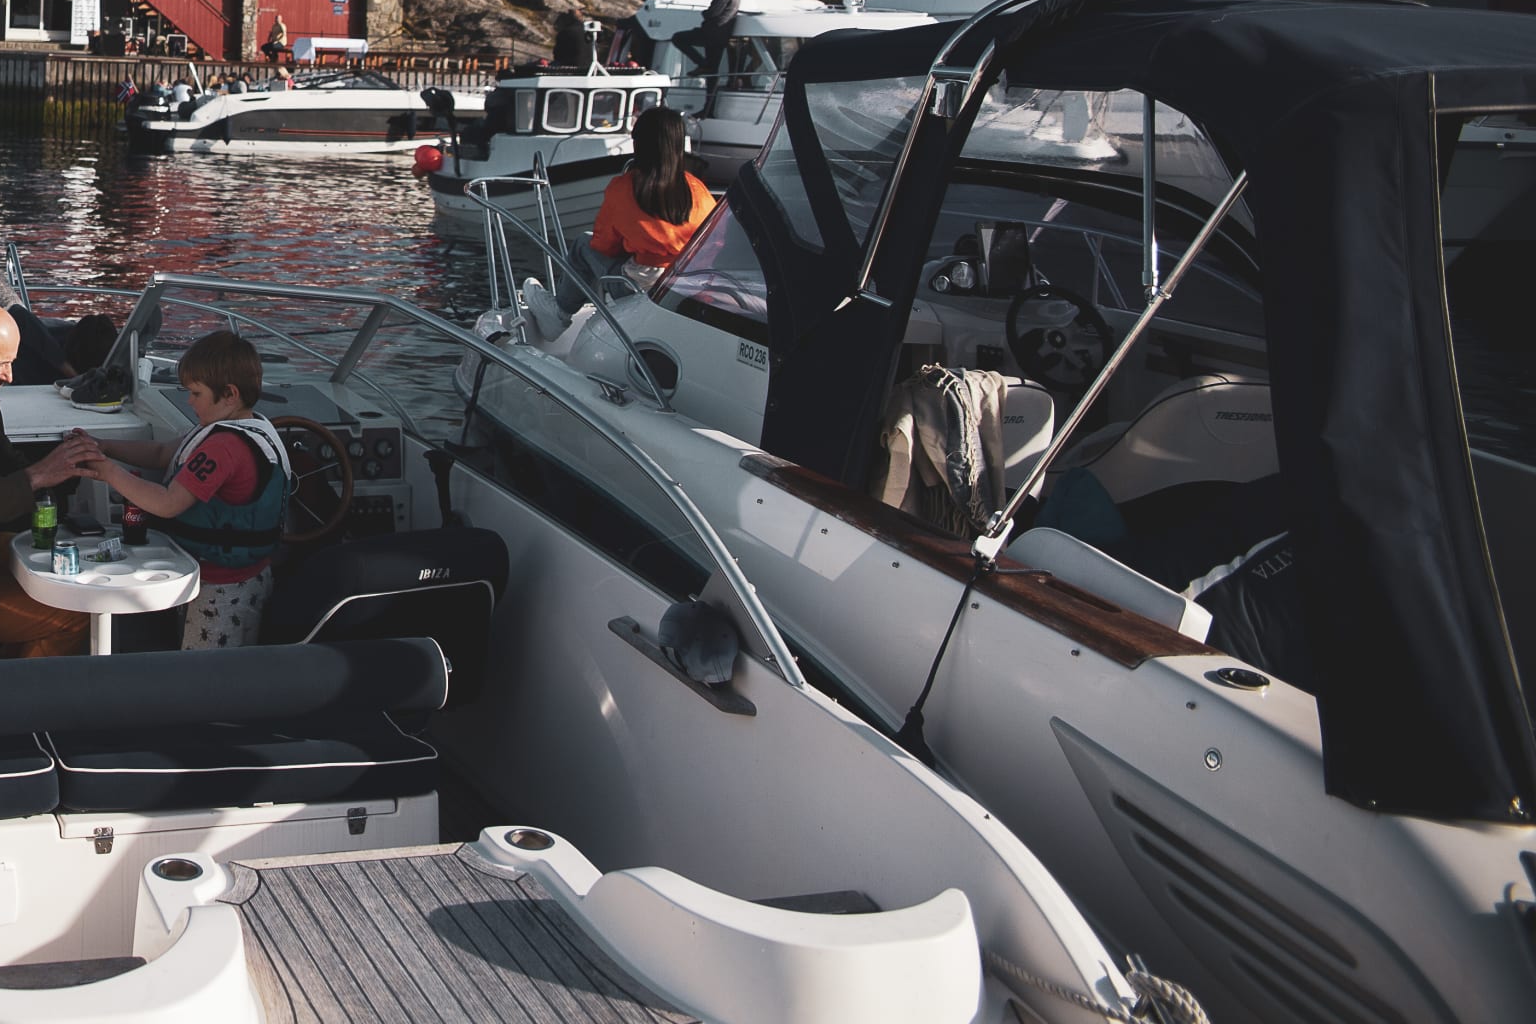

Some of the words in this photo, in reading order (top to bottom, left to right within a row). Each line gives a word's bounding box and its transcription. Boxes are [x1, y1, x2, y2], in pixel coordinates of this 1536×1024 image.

[739, 342, 755, 360] RCO
[754, 348, 767, 365] 236
[187, 451, 217, 482] 82
[418, 567, 450, 581] IBIZA
